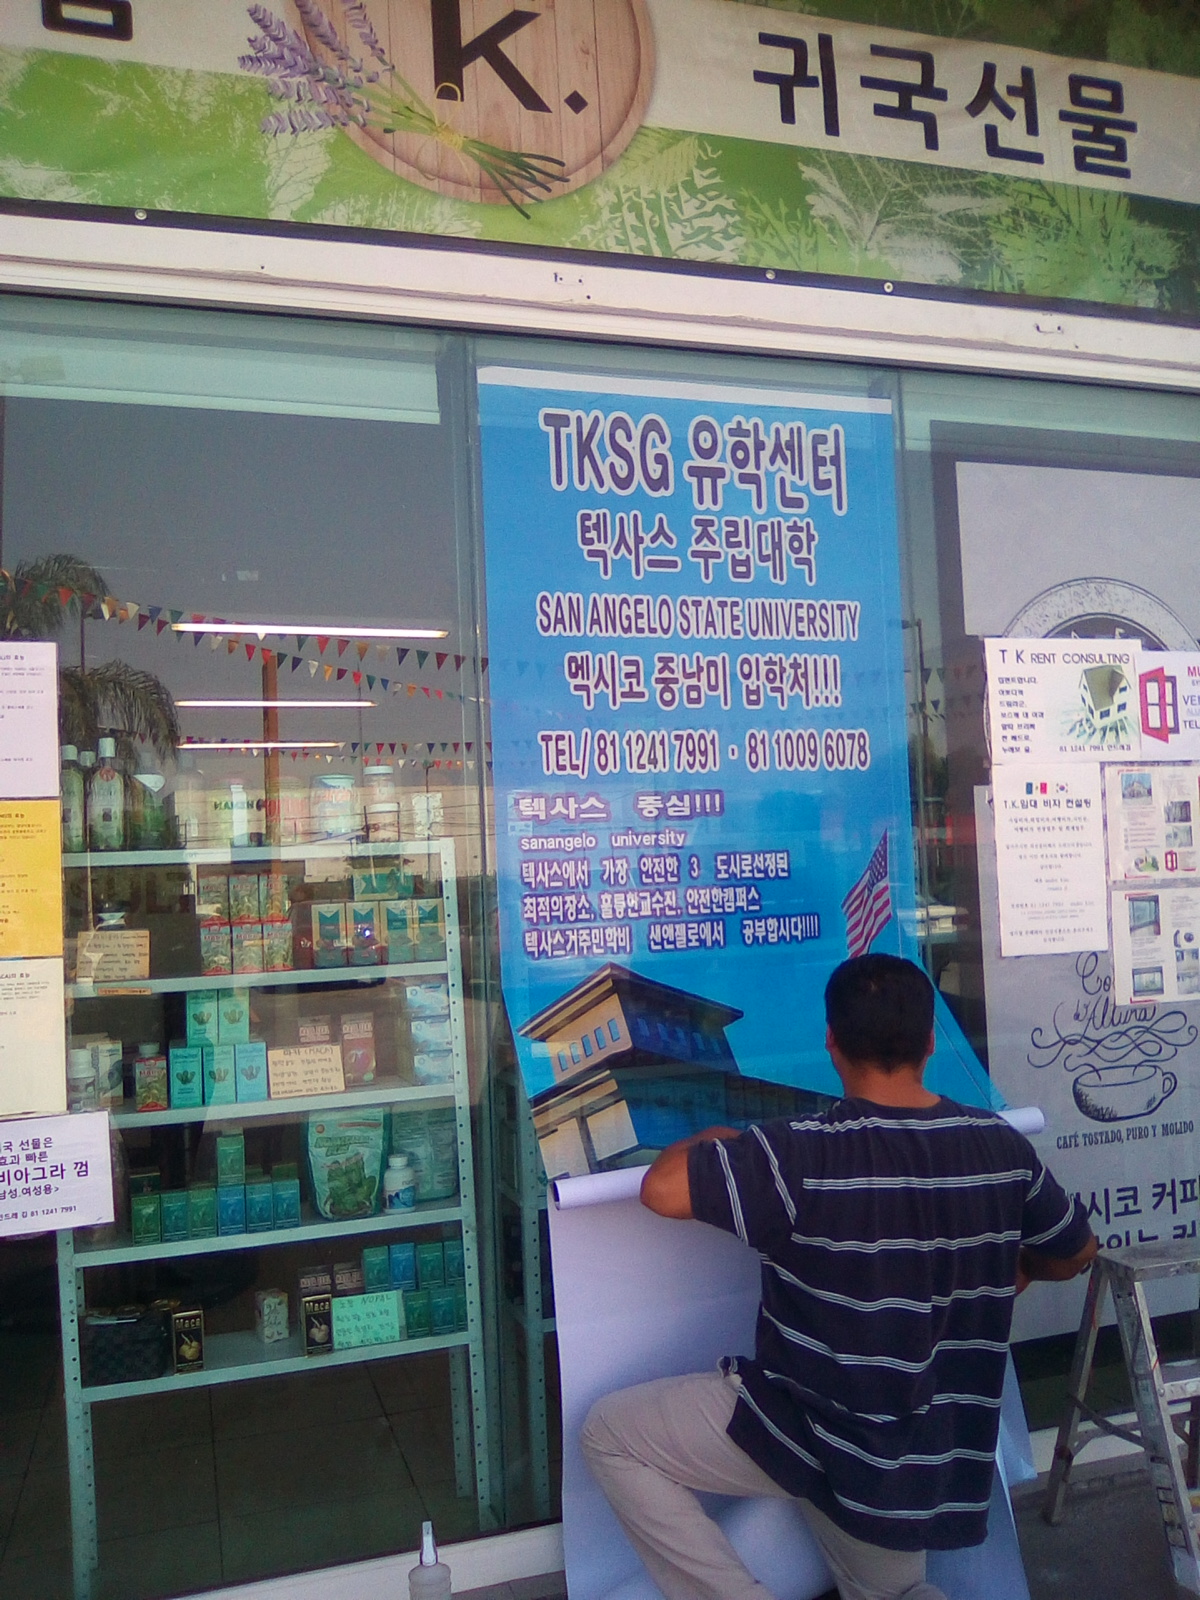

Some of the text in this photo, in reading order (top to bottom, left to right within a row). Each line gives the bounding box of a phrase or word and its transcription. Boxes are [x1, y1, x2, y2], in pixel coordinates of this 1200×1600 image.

[753, 32, 1138, 180] 귀국선물
[542, 409, 846, 513] TKSG 유학센터
[578, 510, 817, 582] 텍사스 주립대학
[538, 593, 860, 640] SAN ANGELO STATE UNIVERSITY
[999, 649, 1130, 664] T K RENT CONSULTING
[566, 653, 841, 708] 멕시코 중남미 입학처!!!
[540, 731, 869, 776] TEL/ 81 1241 7991 81 1009 6078
[518, 794, 721, 820] 텍사스 중심!!!
[521, 830, 685, 851] sanangelo university
[522, 852, 789, 887] 텍사스에서 가장 안전한 3 도시로선정된
[523, 895, 595, 923] 최적의장소,
[686, 886, 760, 914] 안전한캠퍼스
[525, 925, 630, 958] 텍사스거주민학비
[19, 1137, 53, 1151] 선물은
[1057, 1120, 1194, 1149] CAFÉ TOSTADO, PURO Y MOLIDO
[25, 1151, 48, 1163] 빠른
[73, 1160, 89, 1177] 껌
[61, 1205, 77, 1213] 7991
[1076, 1186, 1142, 1224] 시코
[306, 1301, 330, 1312] Maca
[176, 1318, 201, 1329] Maca
